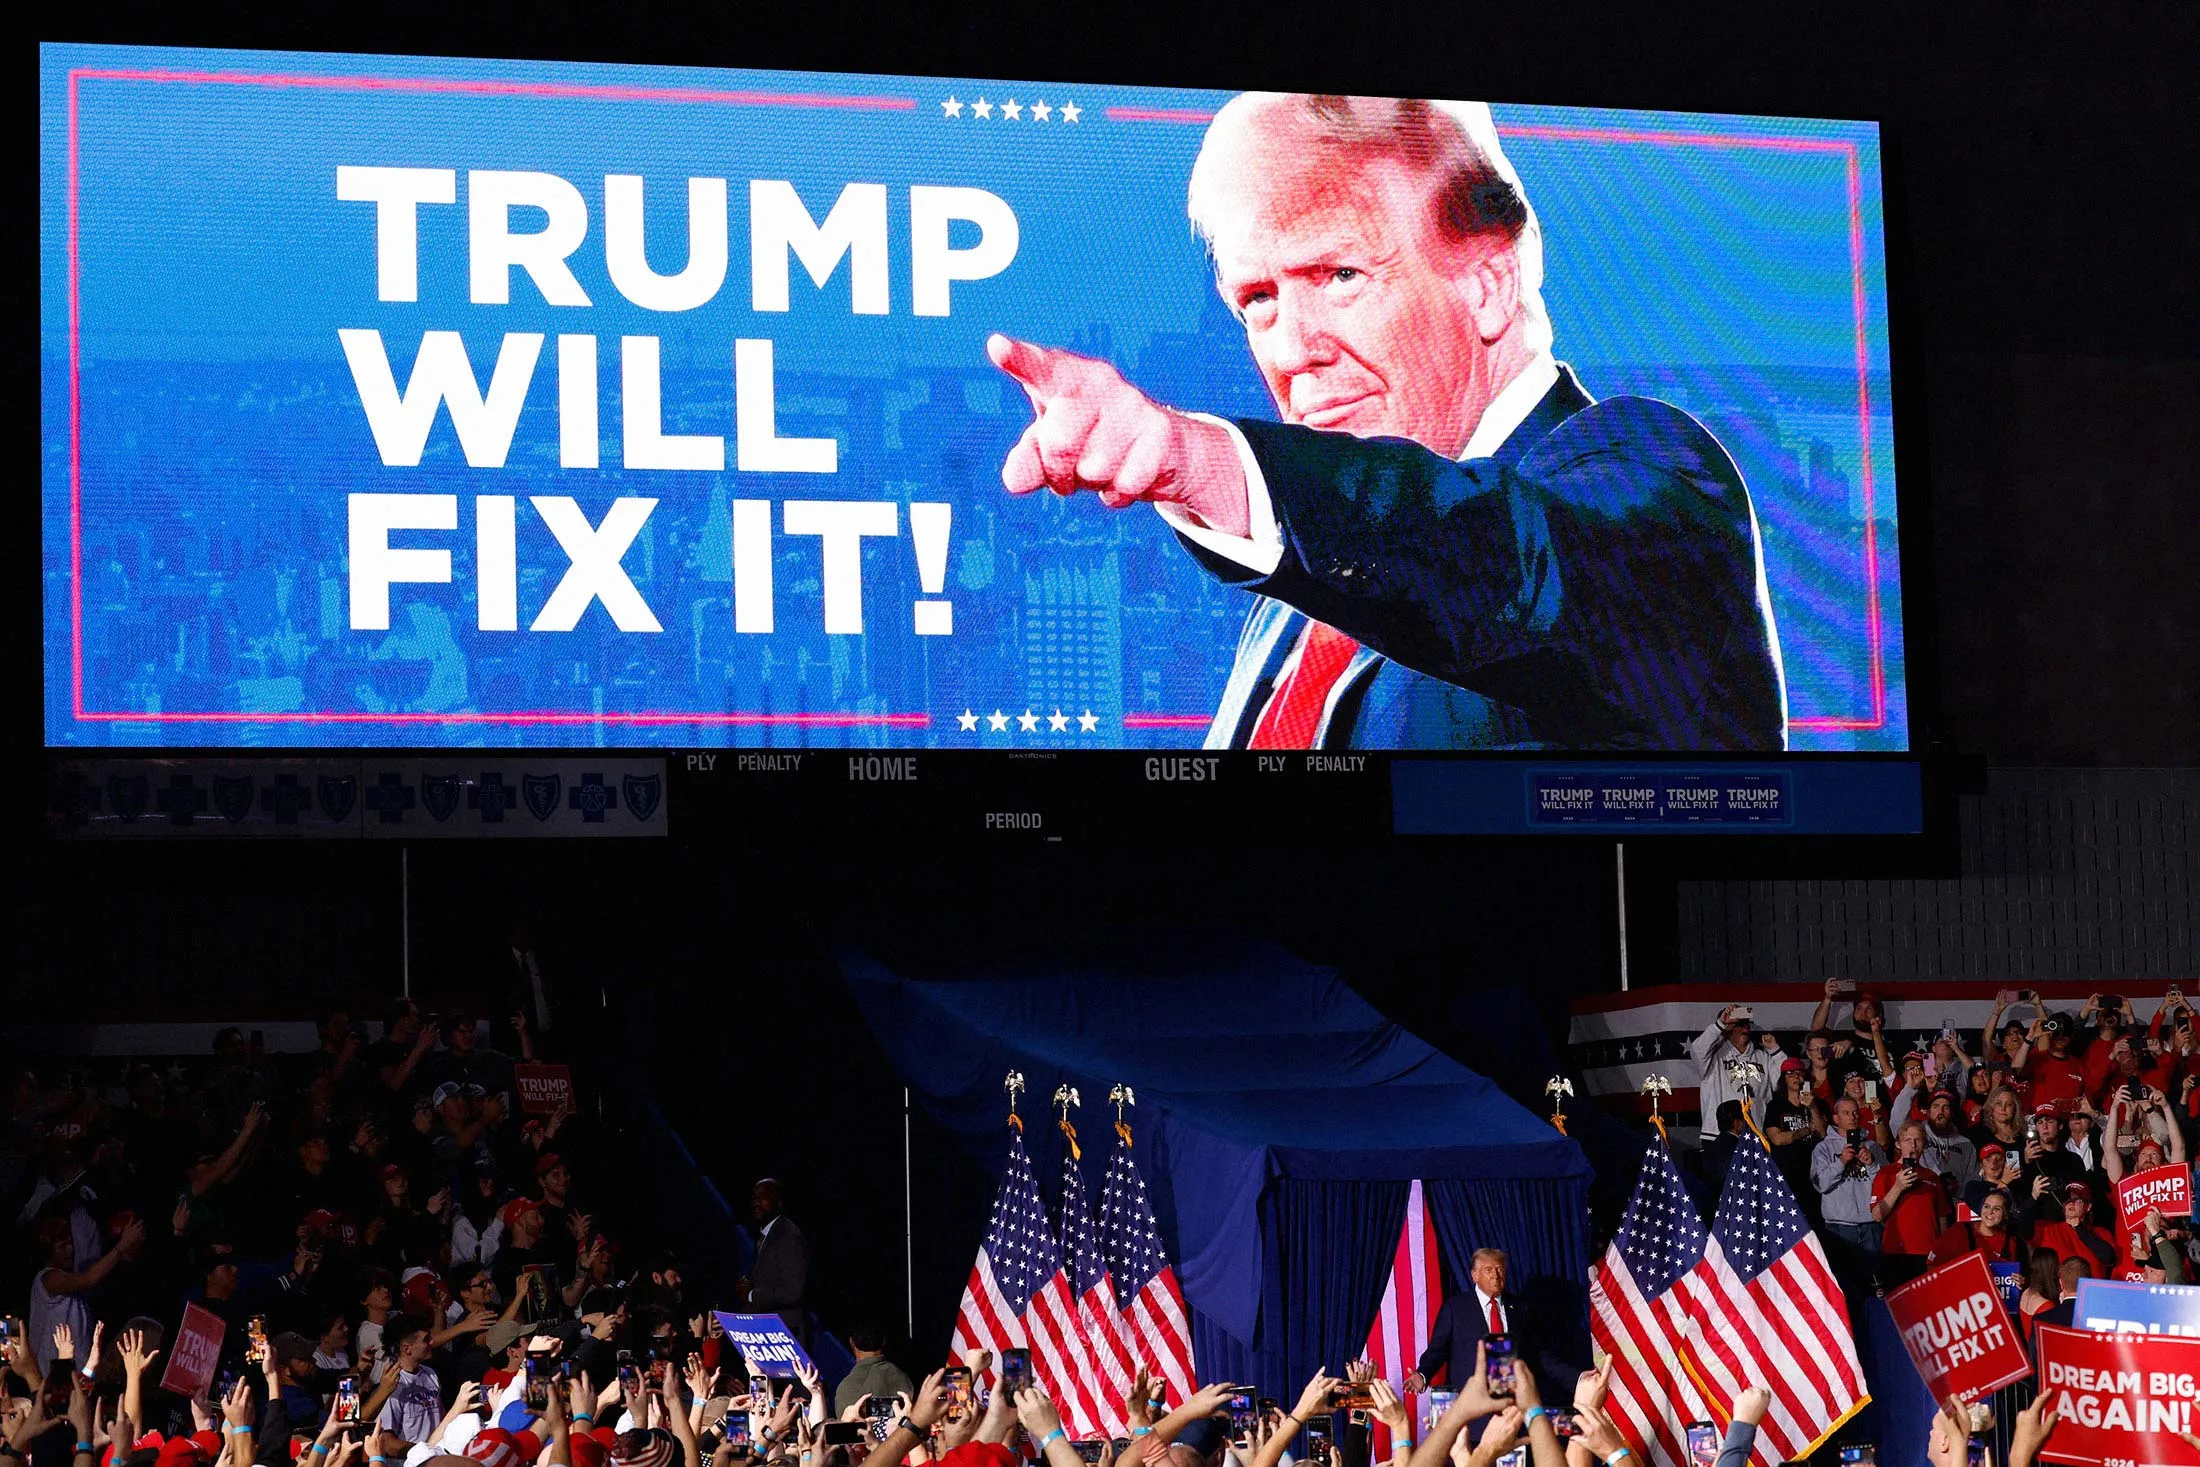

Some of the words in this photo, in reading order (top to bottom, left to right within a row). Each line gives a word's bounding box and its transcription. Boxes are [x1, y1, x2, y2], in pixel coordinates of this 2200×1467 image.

[336, 165, 1019, 318] TRUMP
[339, 329, 838, 474] WILL
[346, 493, 663, 635] FIX
[733, 500, 953, 638] IT!
[686, 754, 716, 771] PLY
[738, 754, 802, 771] PENALTY
[848, 757, 918, 781] HOME
[1144, 757, 1220, 782] GUEST
[1258, 755, 1287, 772] PLY
[1306, 755, 1366, 772] PENALTY
[1540, 788, 1594, 801] TRUMP
[1602, 788, 1655, 801] TRUMP
[1666, 788, 1719, 801] TRUMP
[1727, 788, 1779, 801] TRUMP
[1541, 801, 1565, 809] WILL
[1567, 801, 1582, 809] FIX
[1584, 801, 1593, 809] IT
[1603, 801, 1627, 809] WILL
[1629, 801, 1644, 809] FIX
[1646, 801, 1655, 809] IT
[1667, 801, 1691, 809] WILL
[1693, 801, 1708, 809] FIX
[1710, 801, 1719, 809] IT
[1728, 801, 1751, 809] WILL
[1753, 801, 1768, 809] FIX
[1770, 801, 1779, 809] IT
[985, 812, 1042, 829] PERIOD
[519, 1077, 568, 1093] TRUMP
[521, 1091, 545, 1101] WILL
[2122, 1177, 2185, 1206] TRUMP
[2125, 1199, 2148, 1215] WILL
[2150, 1193, 2170, 1204] FIX
[2173, 1191, 2185, 1201] IT
[1904, 1291, 1994, 1360] TRUMP
[728, 1330, 768, 1345] DREAM
[766, 1330, 795, 1345] BIG,
[1947, 1336, 1985, 1369] FIX
[1982, 1323, 2006, 1351] IT
[741, 1343, 801, 1362] AGAIN!
[175, 1351, 202, 1375] WILL
[2048, 1360, 2141, 1395] DREAM
[2149, 1372, 2200, 1402] BIG,
[1959, 1387, 1980, 1402] 024
[2057, 1390, 2192, 1434] AGAIN!
[2103, 1456, 2135, 1467] 2024
